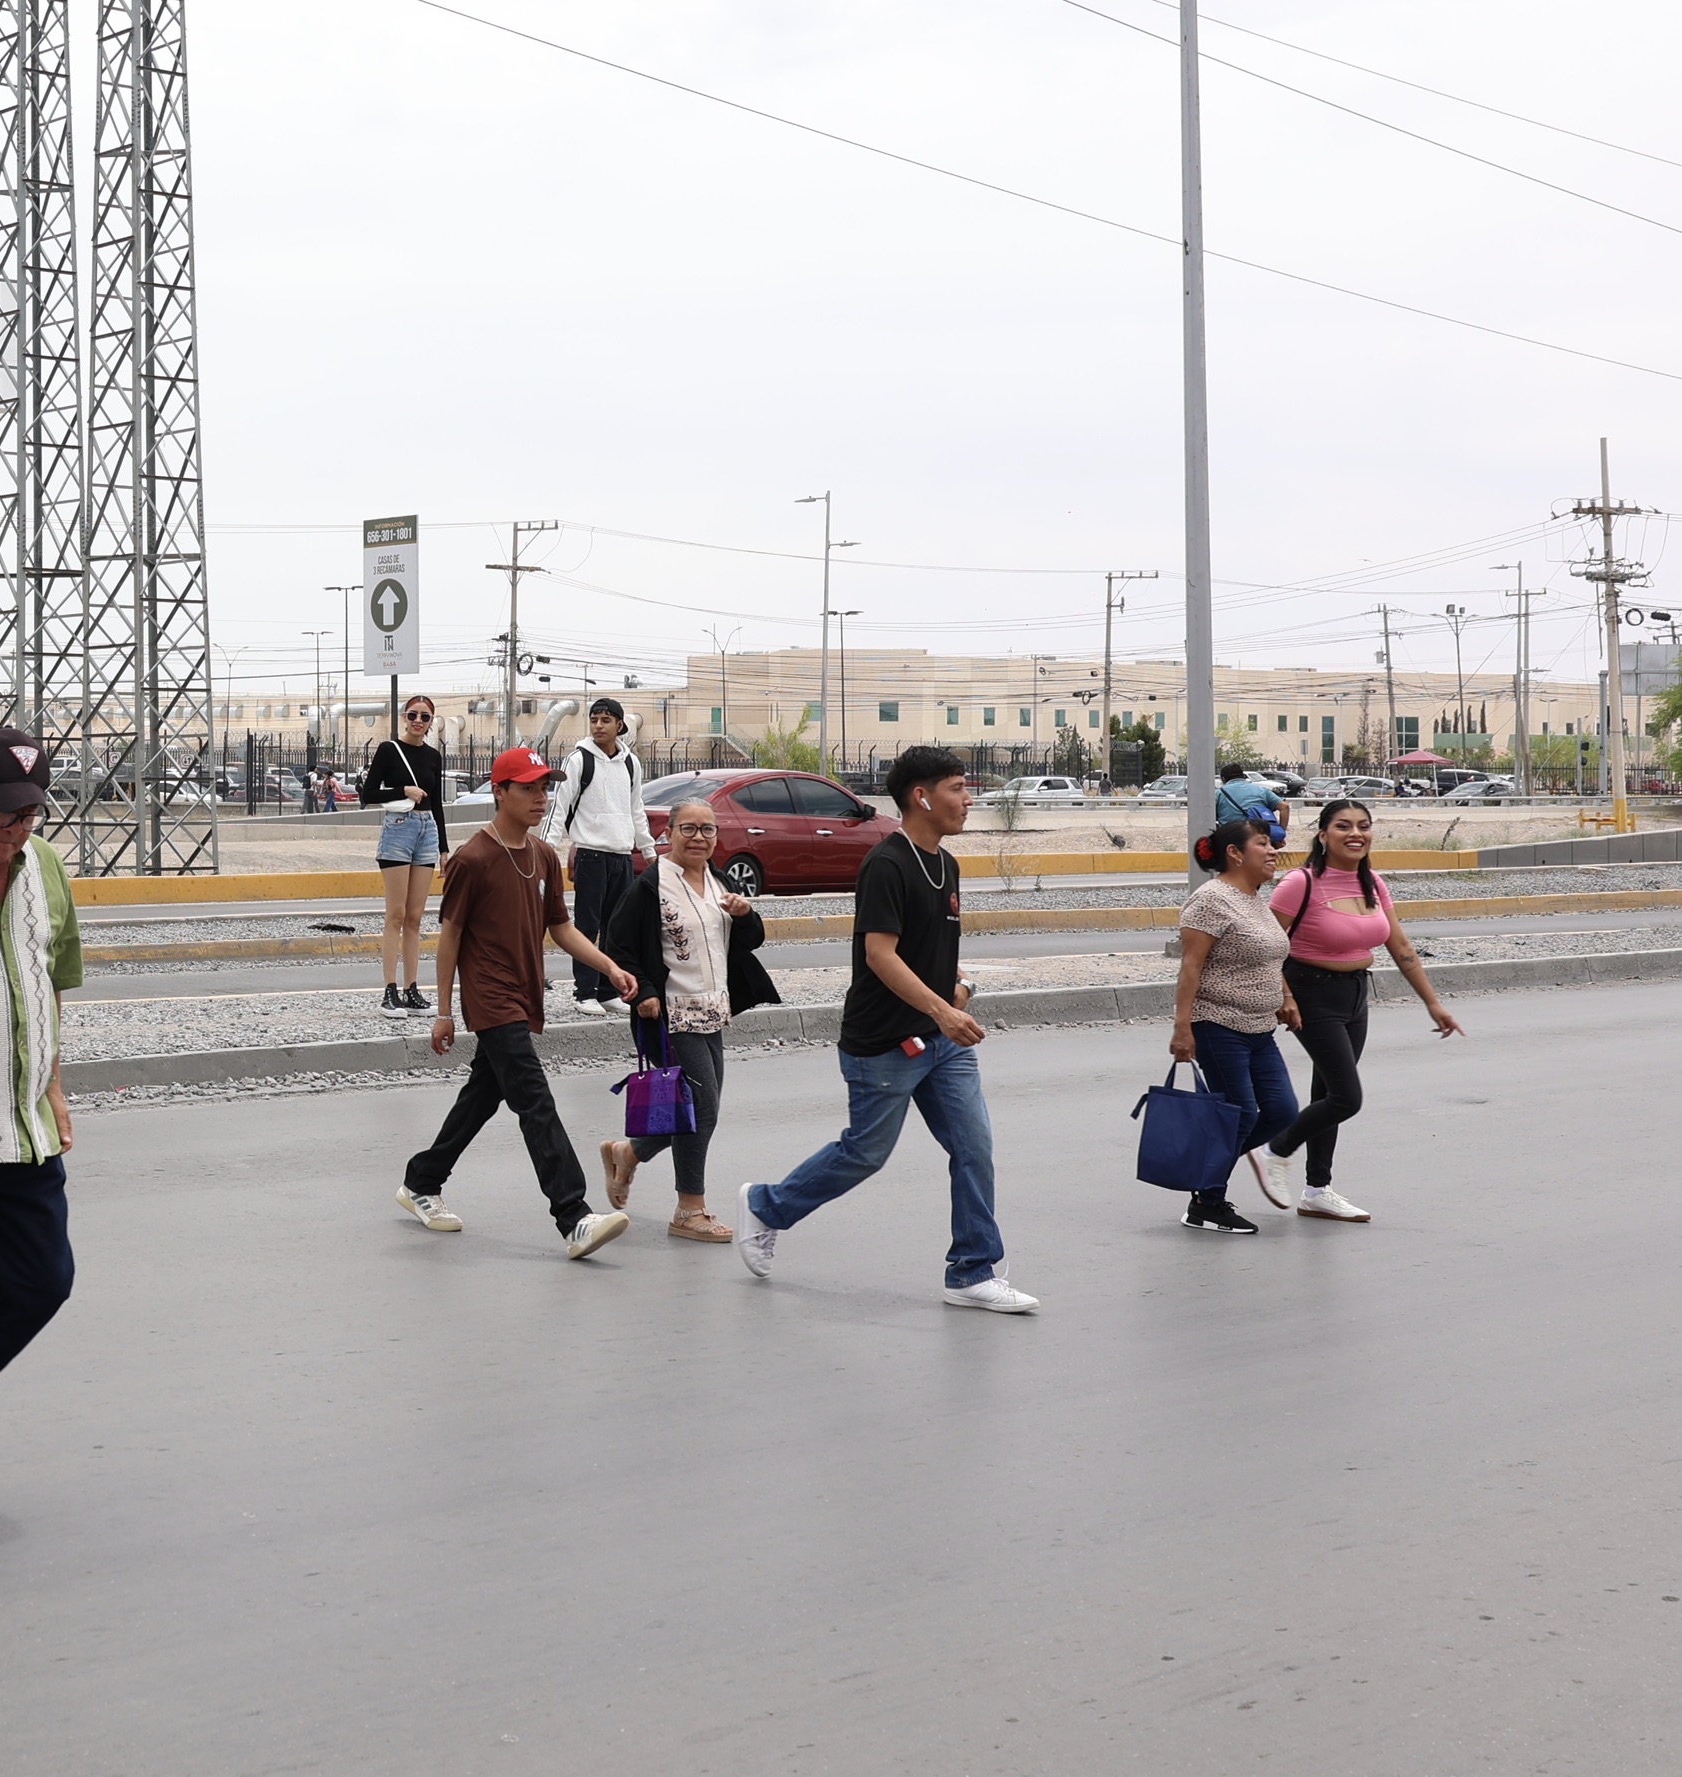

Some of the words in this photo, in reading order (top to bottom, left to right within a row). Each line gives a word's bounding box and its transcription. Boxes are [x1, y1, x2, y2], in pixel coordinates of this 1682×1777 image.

[367, 527, 412, 543] 656-301-1801
[378, 554, 393, 565] CASAS
[393, 553, 400, 564] DE
[373, 565, 377, 576] 3
